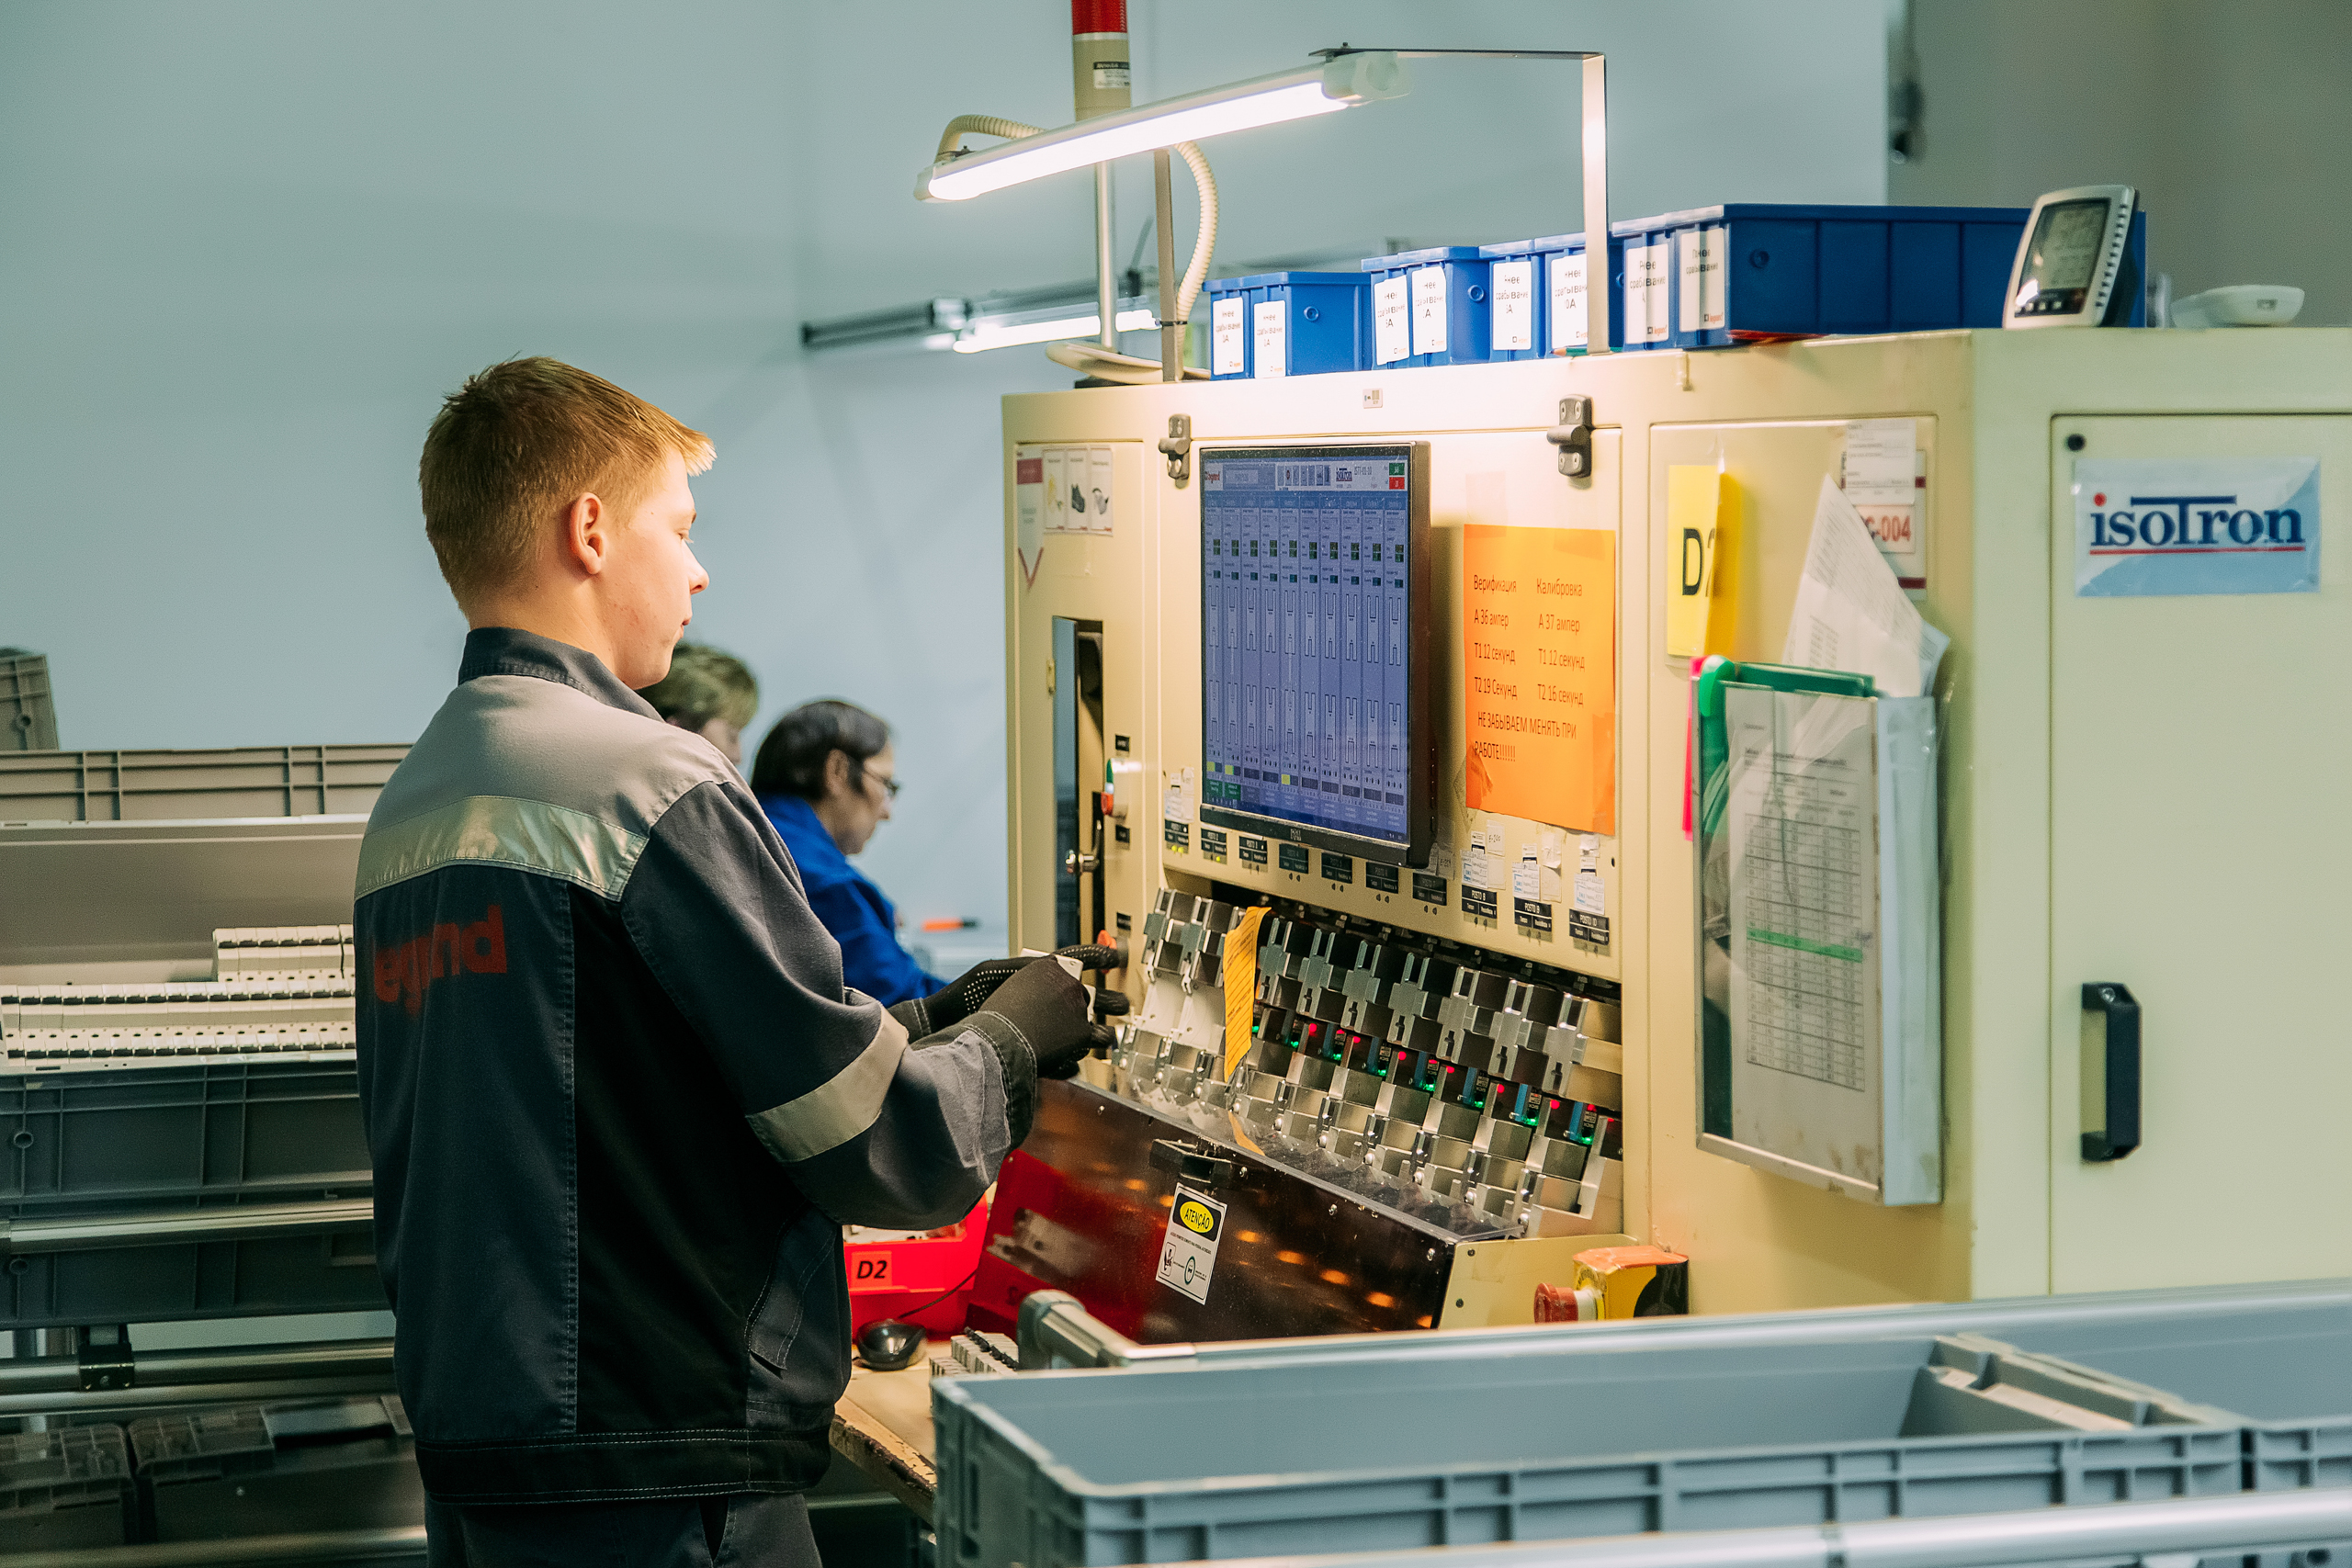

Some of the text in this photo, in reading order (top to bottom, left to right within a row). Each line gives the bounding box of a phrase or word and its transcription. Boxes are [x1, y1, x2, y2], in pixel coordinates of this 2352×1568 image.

[1474, 574, 1517, 595] Верификация
[1536, 578, 1583, 600] Калибровка
[1480, 609, 1488, 625] 36
[1489, 613, 1510, 630] ампер
[1545, 614, 1555, 630] 37
[1556, 618, 1580, 636] ампер
[1483, 643, 1491, 660] 12
[1491, 648, 1516, 665] секунд
[1549, 649, 1557, 666] 12
[1558, 653, 1585, 671] секунд
[1483, 678, 1491, 694] 19
[1492, 679, 1518, 701] Секунд
[1548, 685, 1557, 703] 16
[1558, 689, 1584, 708] секунд
[1477, 711, 1577, 739] НЕ ЗАБЫВАЕМ МЕНЯТЬ ПРИ
[1184, 1208, 1210, 1230] ATENÇÃO
[856, 1260, 888, 1279] D2
